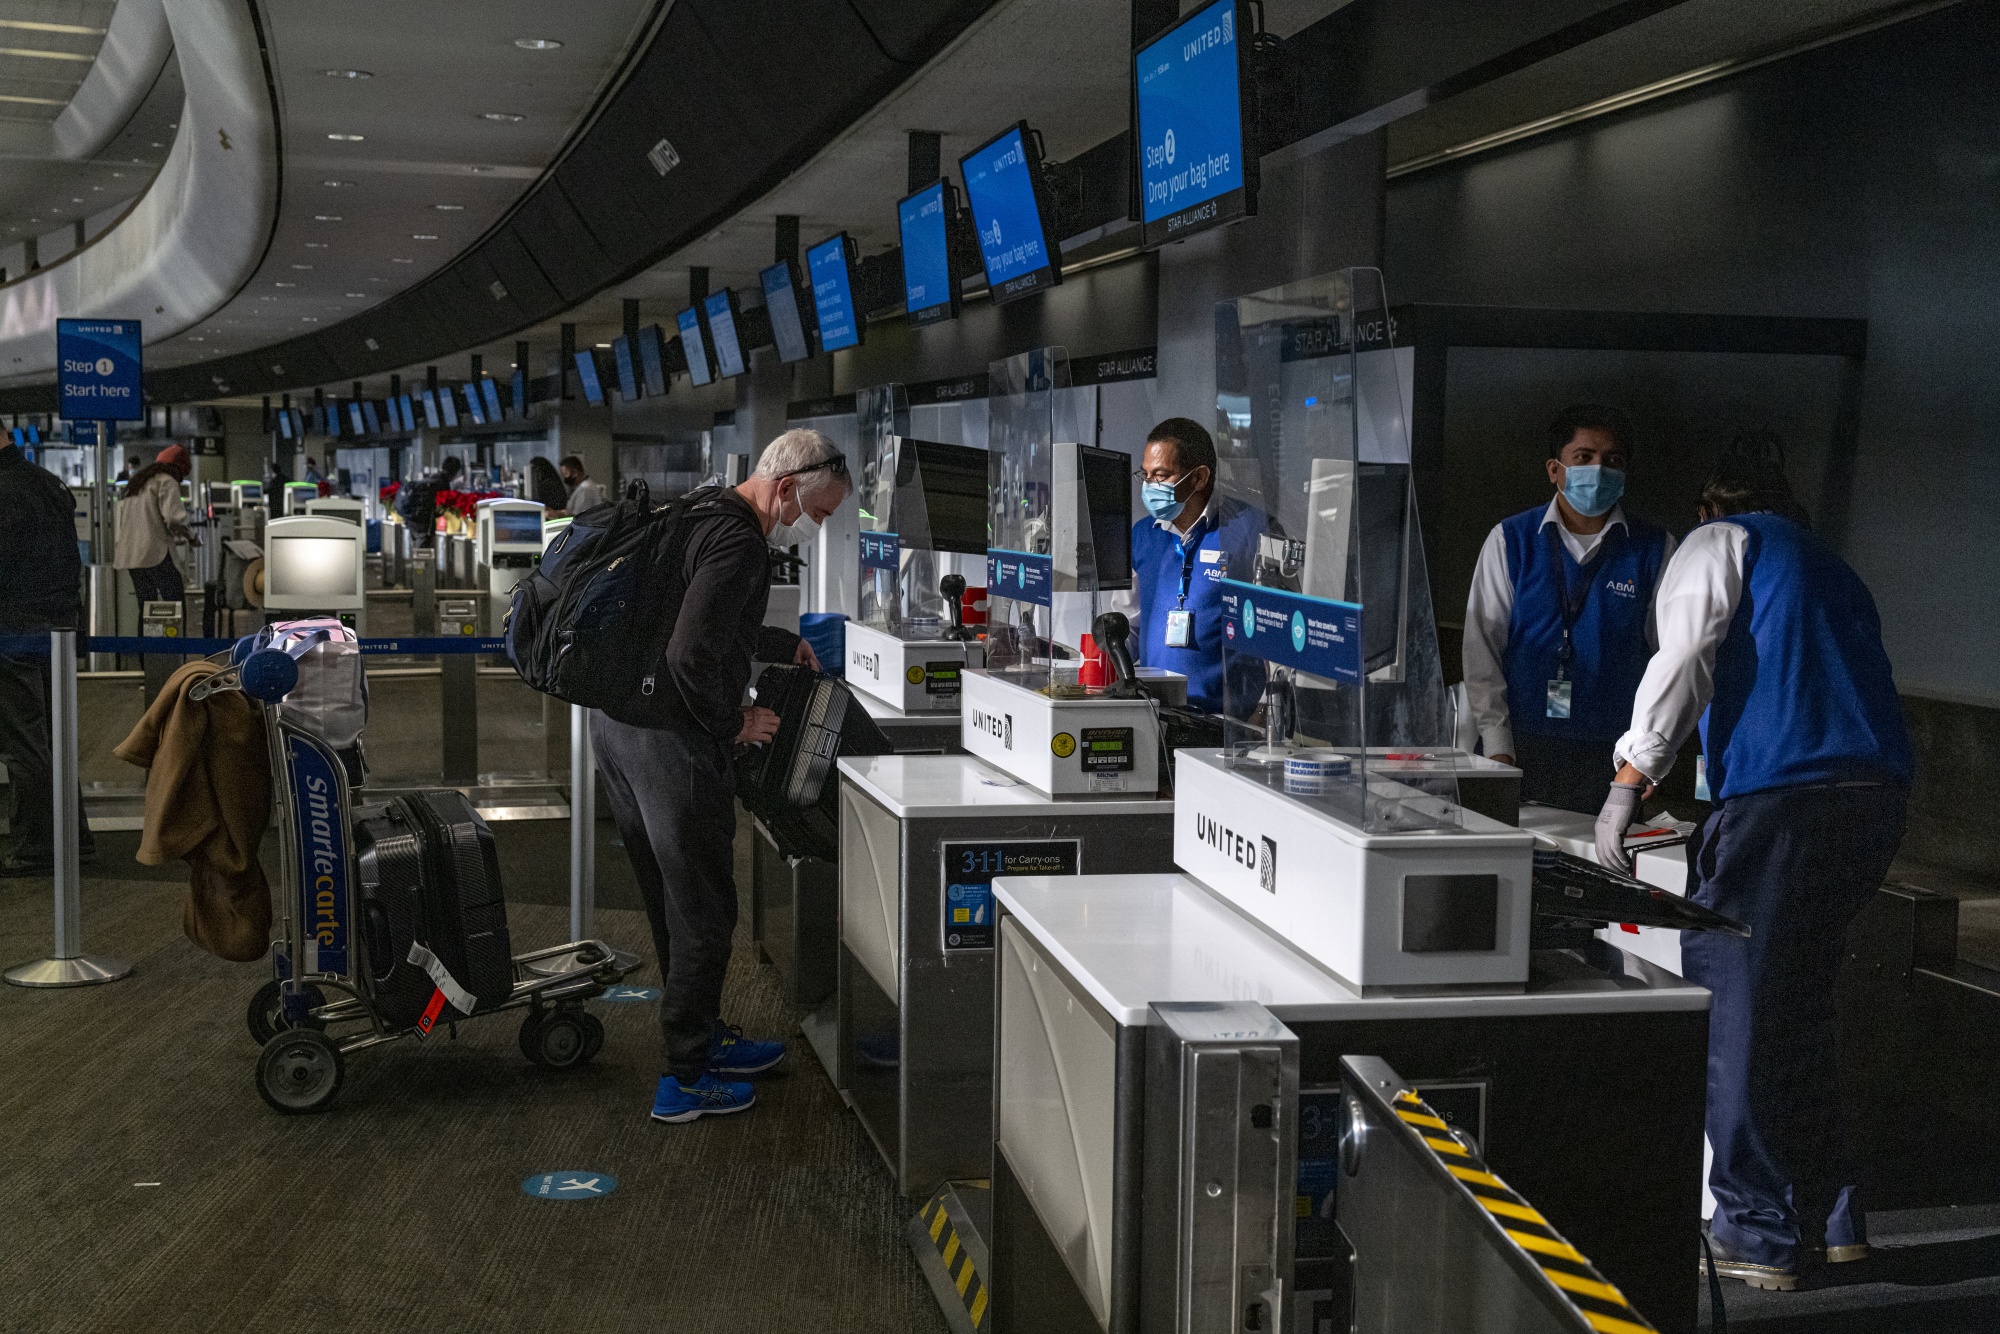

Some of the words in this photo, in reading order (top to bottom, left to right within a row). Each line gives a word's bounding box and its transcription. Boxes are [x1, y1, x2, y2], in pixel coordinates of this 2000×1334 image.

[1183, 26, 1221, 62] UNITED
[992, 150, 1016, 173] UNITED
[1146, 144, 1165, 169] Step
[1148, 180, 1168, 204] Drop
[1169, 170, 1189, 202] your
[1190, 162, 1207, 189] bag
[1208, 152, 1230, 178] here
[1168, 216, 1182, 232] STAR
[1182, 204, 1210, 226] ALLIANCE
[981, 229, 995, 247] Step
[987, 254, 1002, 274] Drop
[1000, 250, 1014, 272] your
[1012, 244, 1027, 265] bag
[1024, 239, 1039, 259] here
[64, 359, 94, 374] Step
[1098, 361, 1116, 377] STAR
[1117, 356, 1153, 375] ALLIANCE
[64, 384, 97, 397] Start
[100, 384, 130, 397] here
[1606, 581, 1635, 594] ABM
[853, 651, 873, 672] UNITED
[973, 708, 1003, 739] UNITED
[1197, 813, 1256, 870] UNITED
[961, 850, 1004, 873] 3-1-1
[1005, 855, 1017, 865] for
[1019, 855, 1061, 866] Carry-ons
[1007, 864, 1029, 872] Prepare
[954, 886, 960, 897] 3
